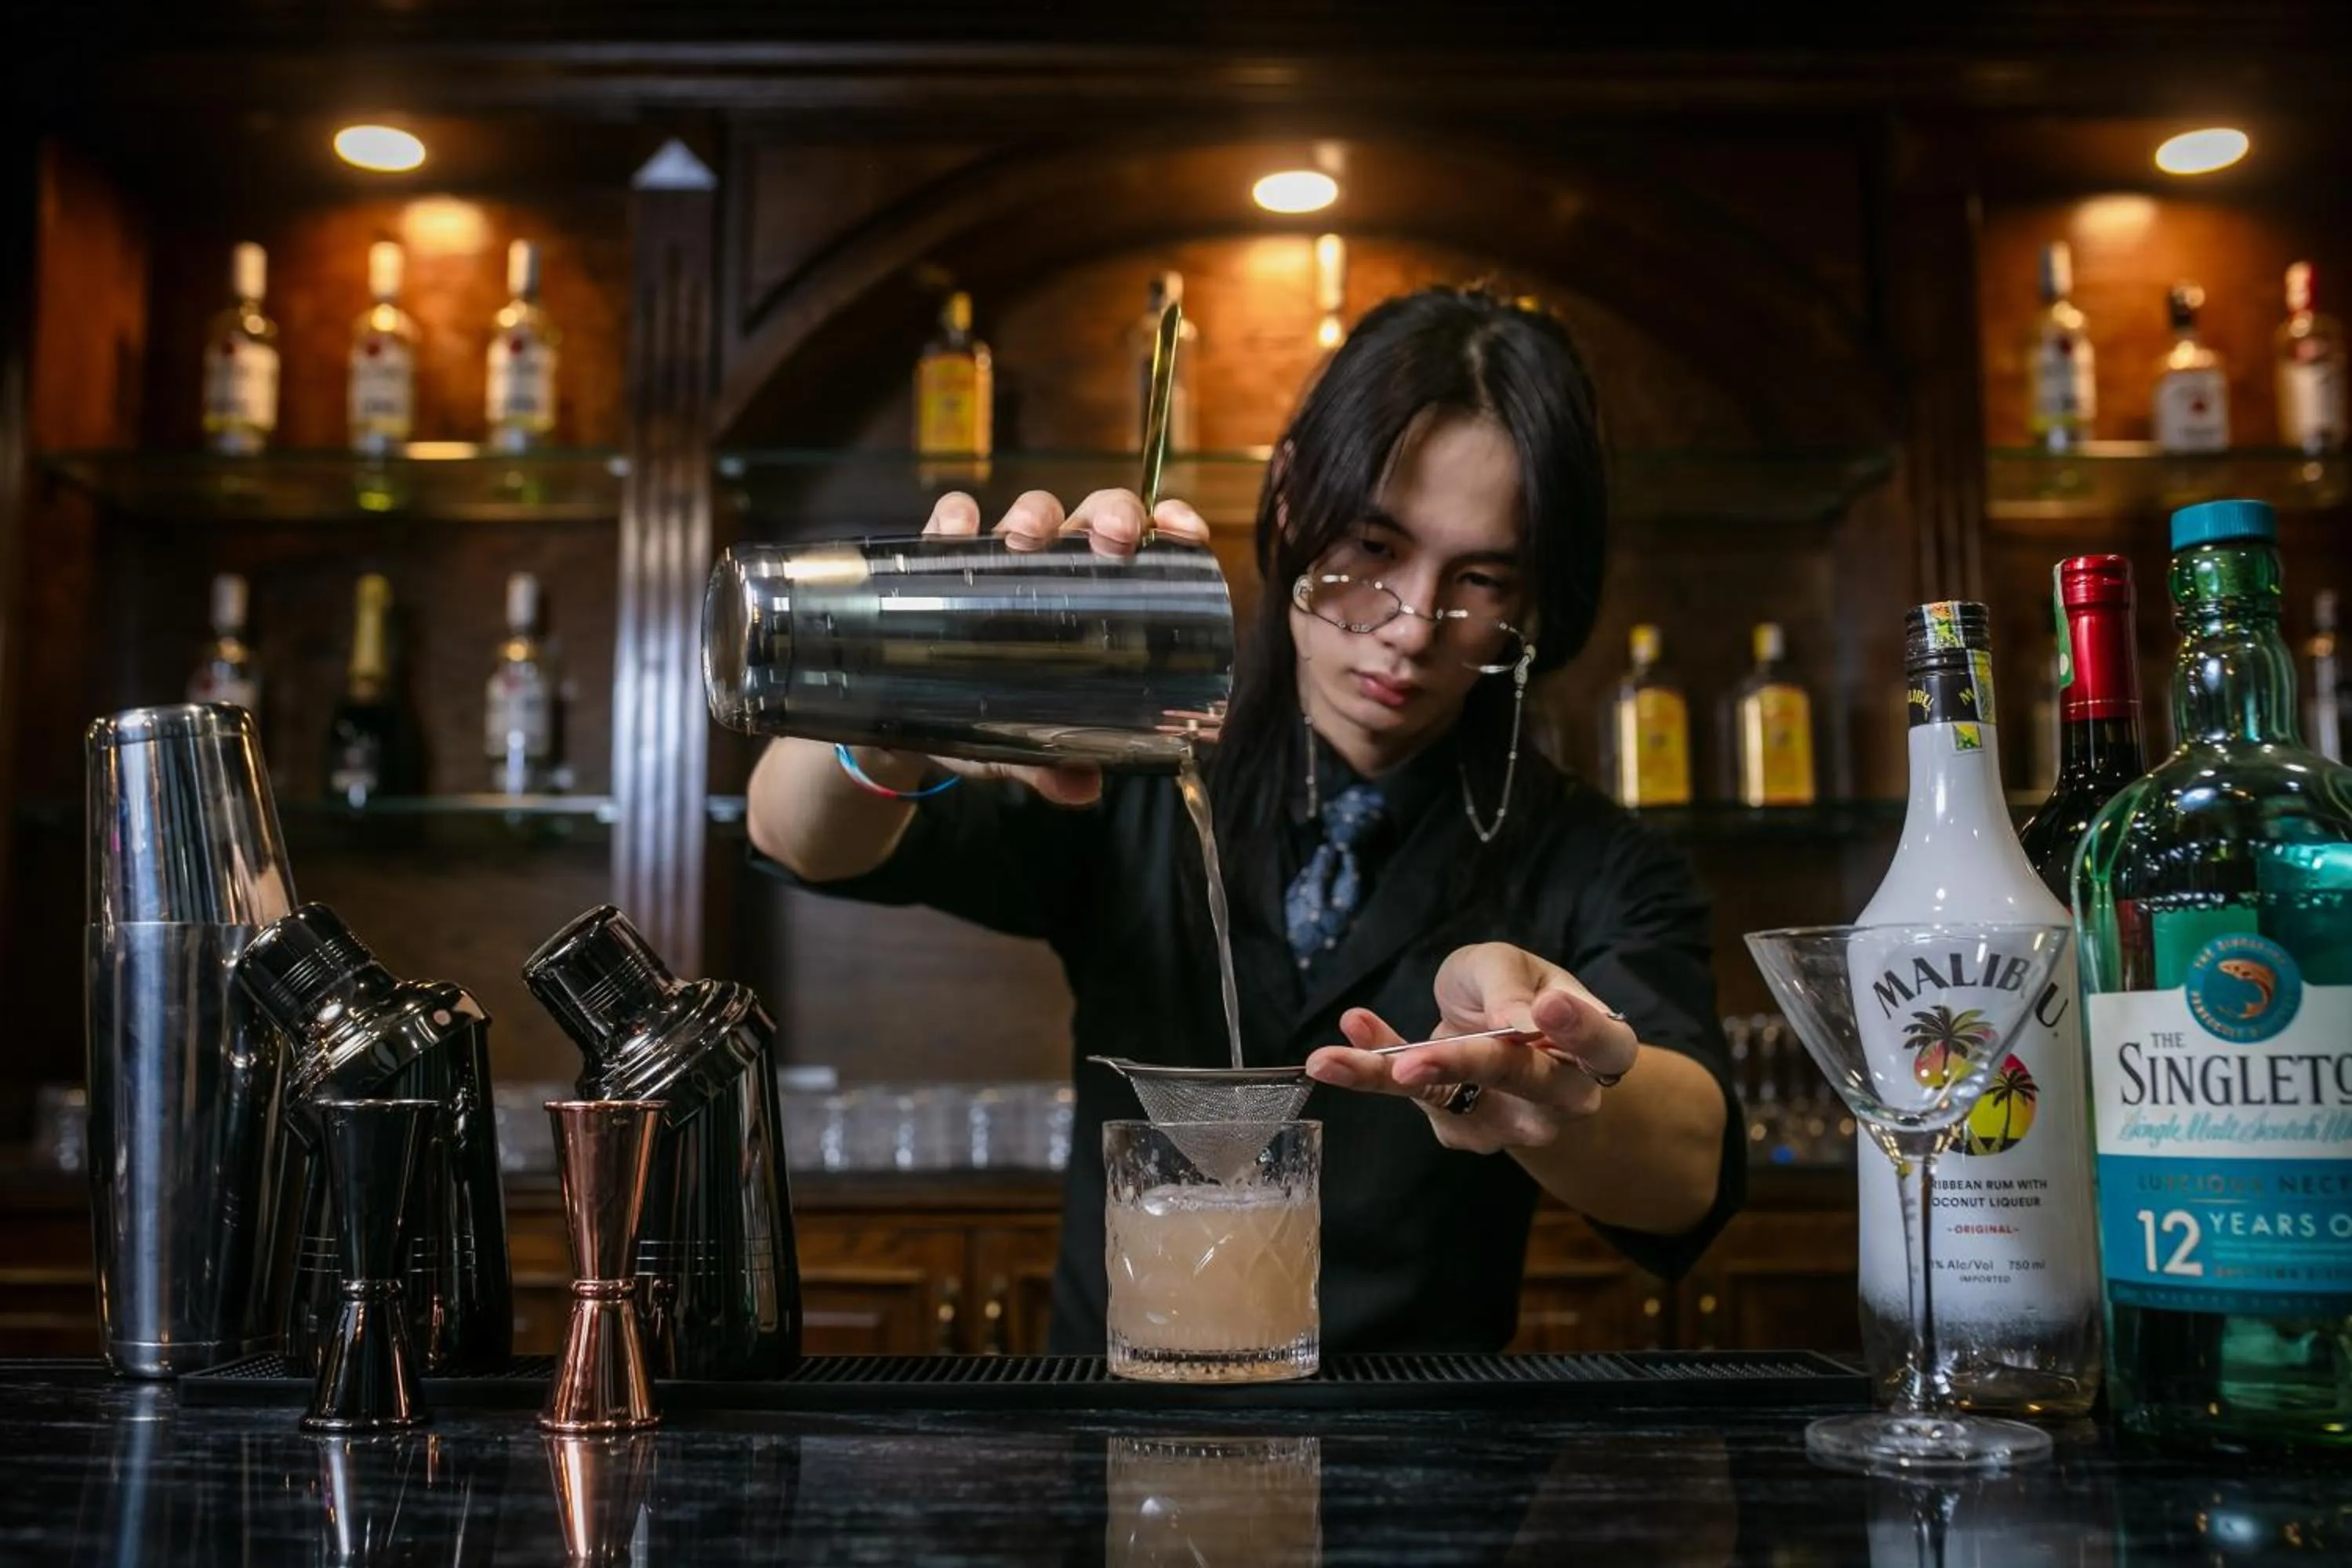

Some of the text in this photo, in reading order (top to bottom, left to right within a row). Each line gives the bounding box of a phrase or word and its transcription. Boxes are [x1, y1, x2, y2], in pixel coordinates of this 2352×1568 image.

[1873, 953, 2068, 1028] MALIBU
[2151, 1032, 2186, 1048] THE
[1987, 1180, 2013, 1190] RUM
[2017, 1179, 2048, 1190] WITH
[1931, 1197, 2042, 1207] OCONUT LIQUEUR
[2136, 1208, 2204, 1277] 12
[2208, 1211, 2318, 1238] YEARS
